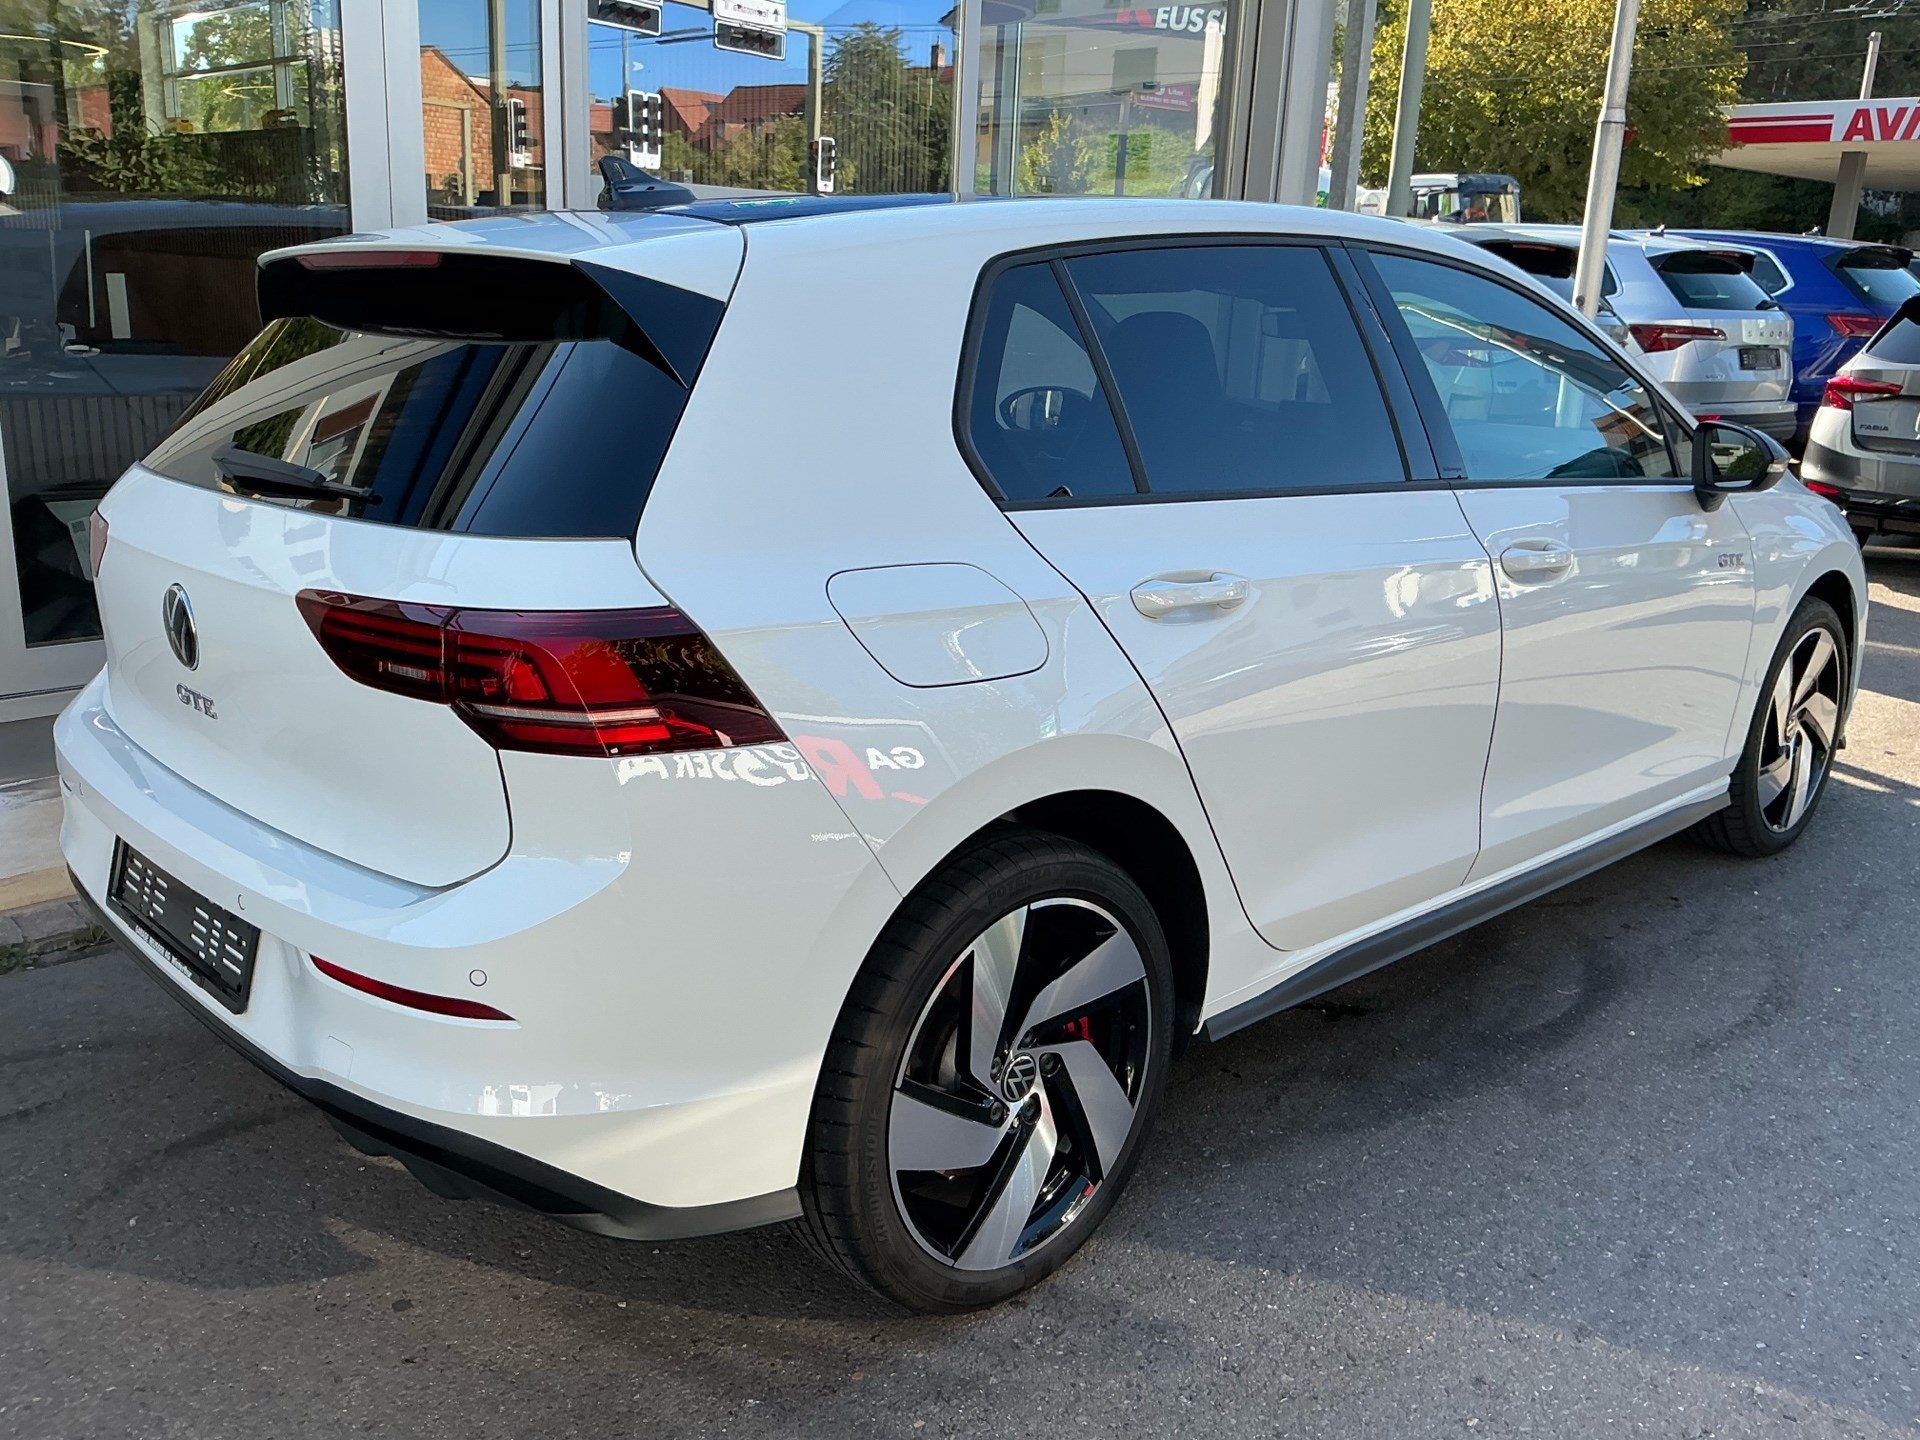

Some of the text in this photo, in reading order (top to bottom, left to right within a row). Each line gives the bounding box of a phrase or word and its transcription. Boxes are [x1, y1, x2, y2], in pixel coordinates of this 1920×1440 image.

[1842, 106, 1920, 142] AVI
[1859, 423, 1889, 432] FABIA
[1718, 553, 1745, 568] GTE
[176, 683, 218, 720] GTE
